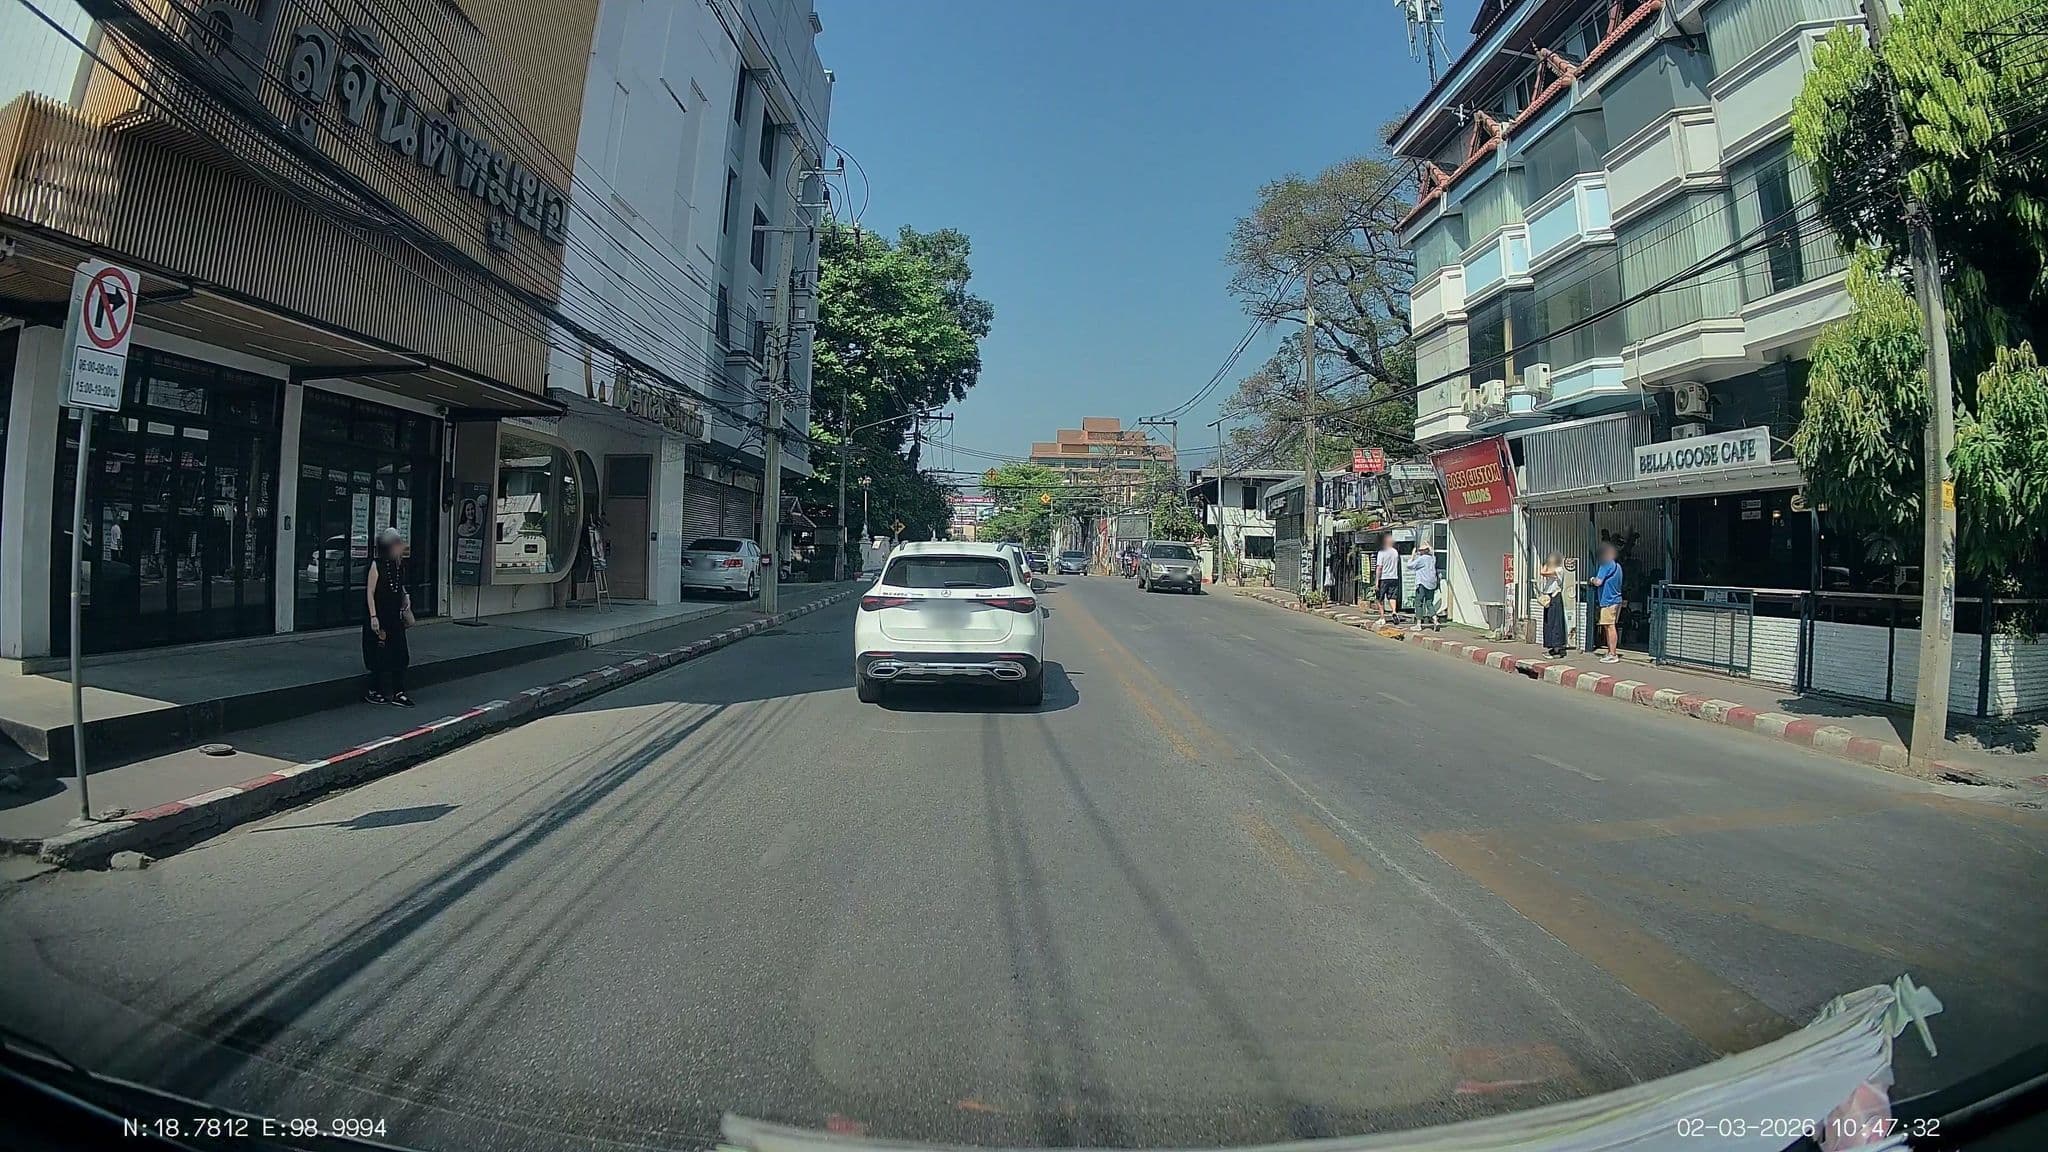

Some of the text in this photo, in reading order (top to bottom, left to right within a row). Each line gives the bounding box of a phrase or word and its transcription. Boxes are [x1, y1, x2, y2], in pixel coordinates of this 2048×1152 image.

[1639, 438, 1757, 474] BELLA GOOSE CAFE
[1446, 462, 1502, 491] BOSS CUSTOM
[1462, 487, 1492, 505] TAILORS
